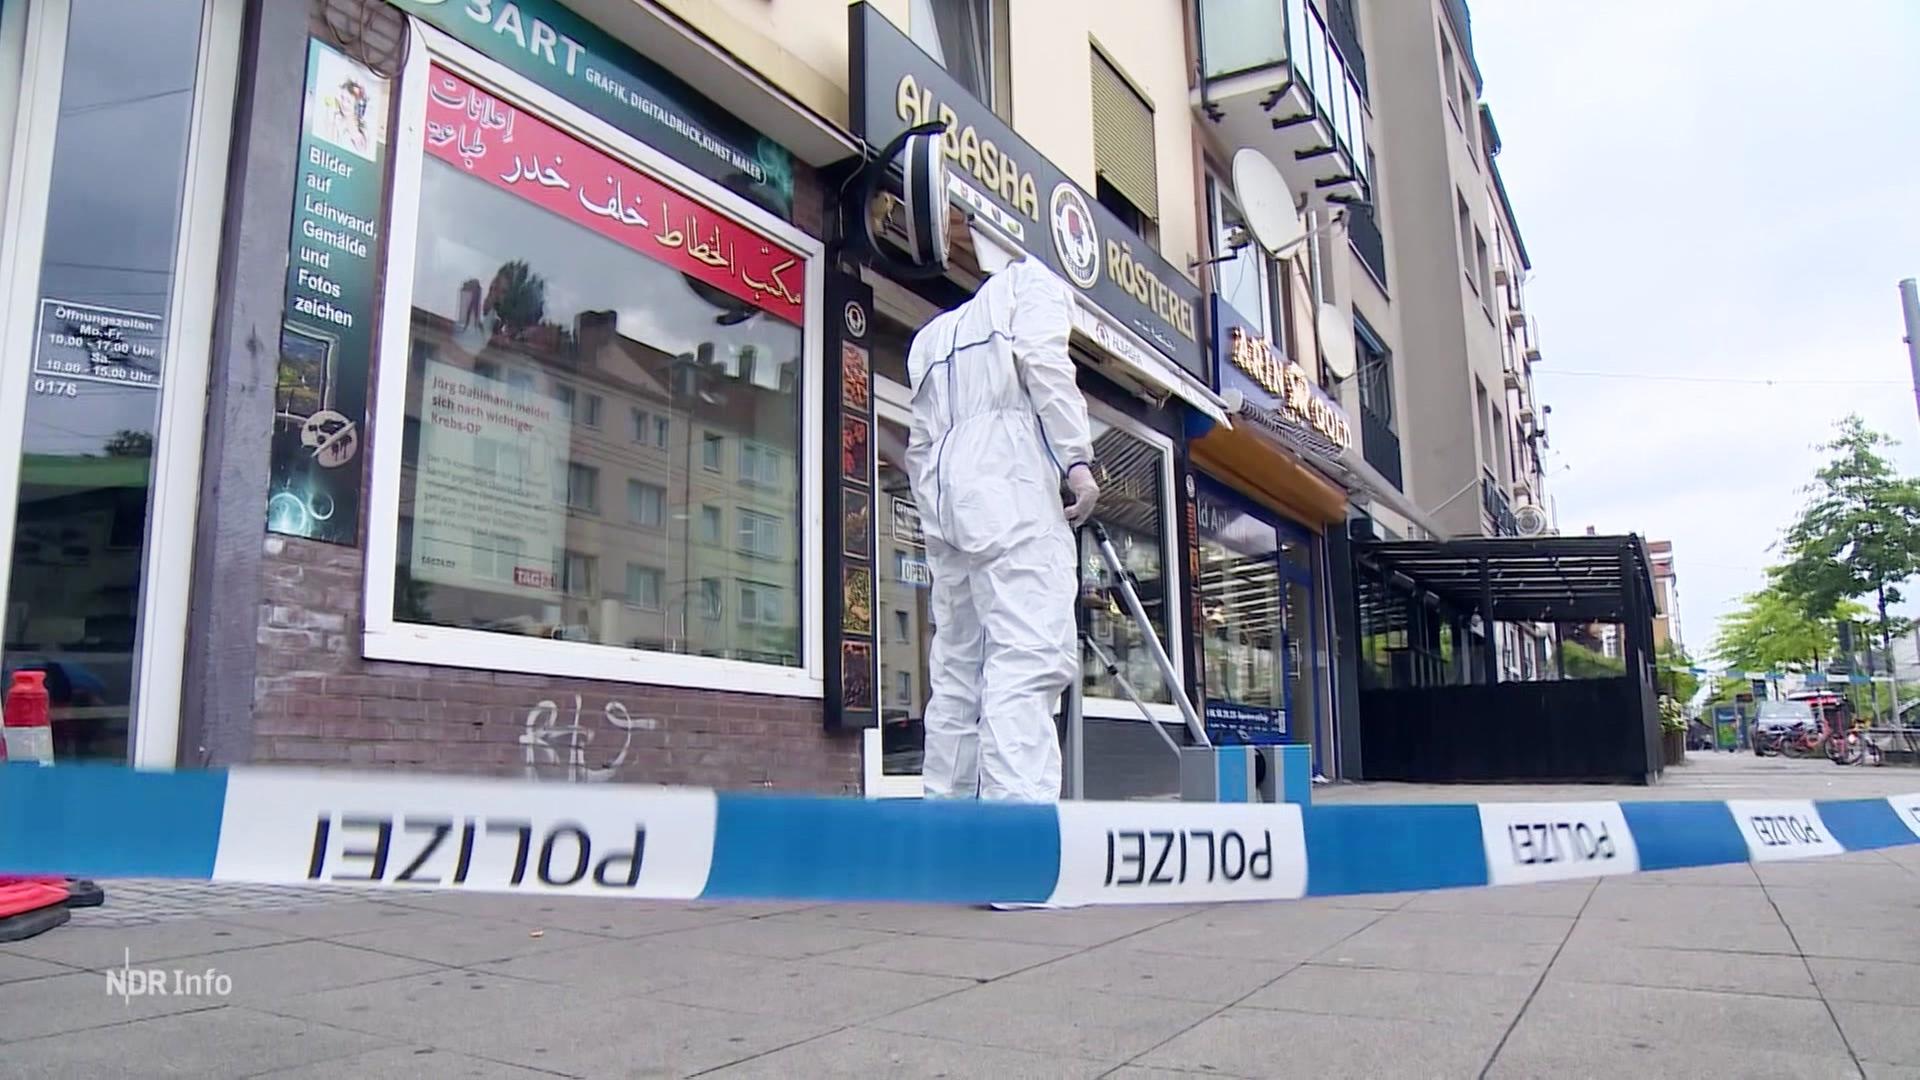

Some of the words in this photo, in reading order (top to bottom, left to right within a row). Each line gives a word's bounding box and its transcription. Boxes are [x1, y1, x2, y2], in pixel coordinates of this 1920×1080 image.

[309, 146, 353, 179] Bilder
[306, 174, 332, 194] auf
[304, 194, 378, 241] Leinwand,
[303, 220, 367, 258] Gemälde
[300, 245, 330, 269] und
[298, 268, 341, 298] Fotos
[1106, 238, 1196, 342] RÖSTEREI
[294, 296, 352, 328] zeichen
[132, 344, 155, 357] Uhr
[131, 369, 153, 383] Uhr
[431, 395, 454, 411] sich
[904, 562, 928, 583] OPEN
[307, 809, 647, 889] POLIZEI
[1104, 828, 1272, 887] POLIZEI
[1508, 820, 1616, 866] POLIZEI
